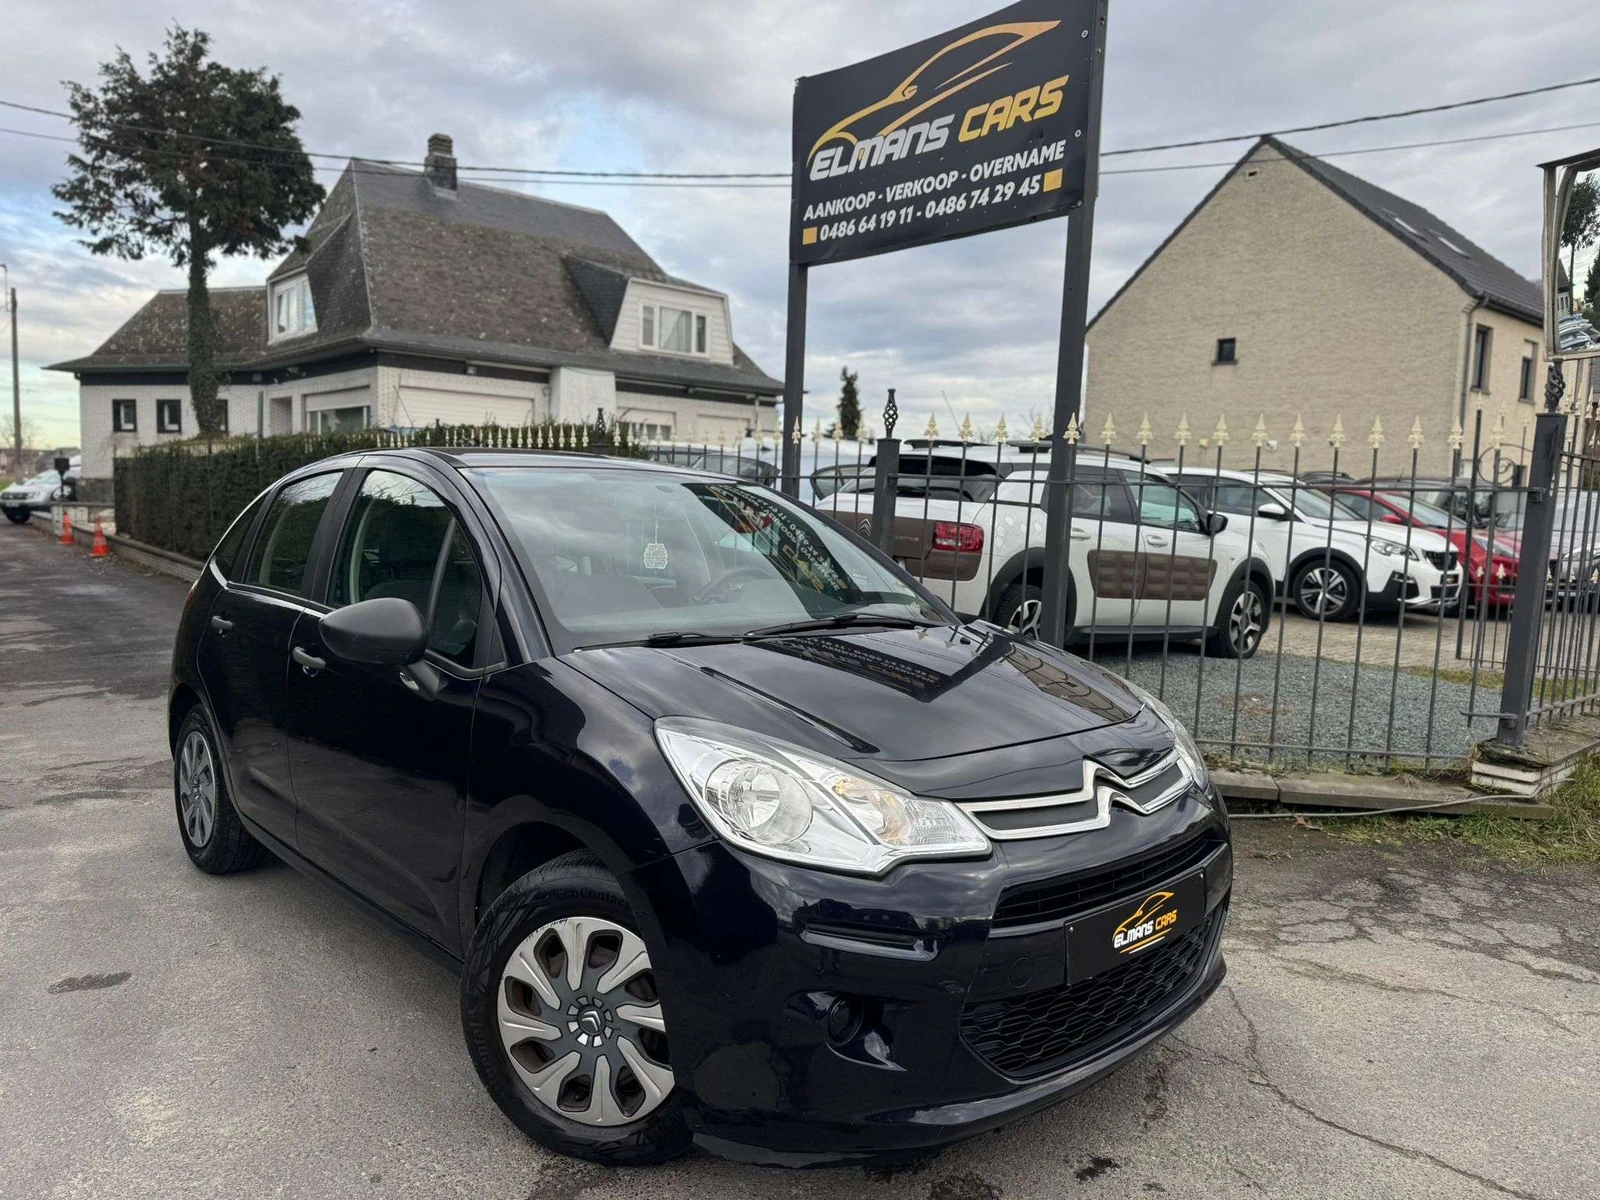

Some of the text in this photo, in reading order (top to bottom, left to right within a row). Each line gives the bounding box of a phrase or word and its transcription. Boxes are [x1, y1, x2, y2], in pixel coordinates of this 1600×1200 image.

[809, 75, 1069, 181] ELMANS CARS
[803, 188, 876, 221] AANKOOP
[885, 171, 958, 203] VERKOOP
[969, 140, 1066, 182] OVERNAME
[820, 217, 855, 241] 0486
[858, 212, 876, 232] 64
[879, 209, 896, 227] 19
[899, 205, 914, 223] 11
[925, 191, 966, 219] 0486
[969, 186, 989, 209] 74
[994, 181, 1015, 202] 29
[1017, 174, 1040, 197] 45
[1114, 909, 1177, 948] ELMANS CARS
